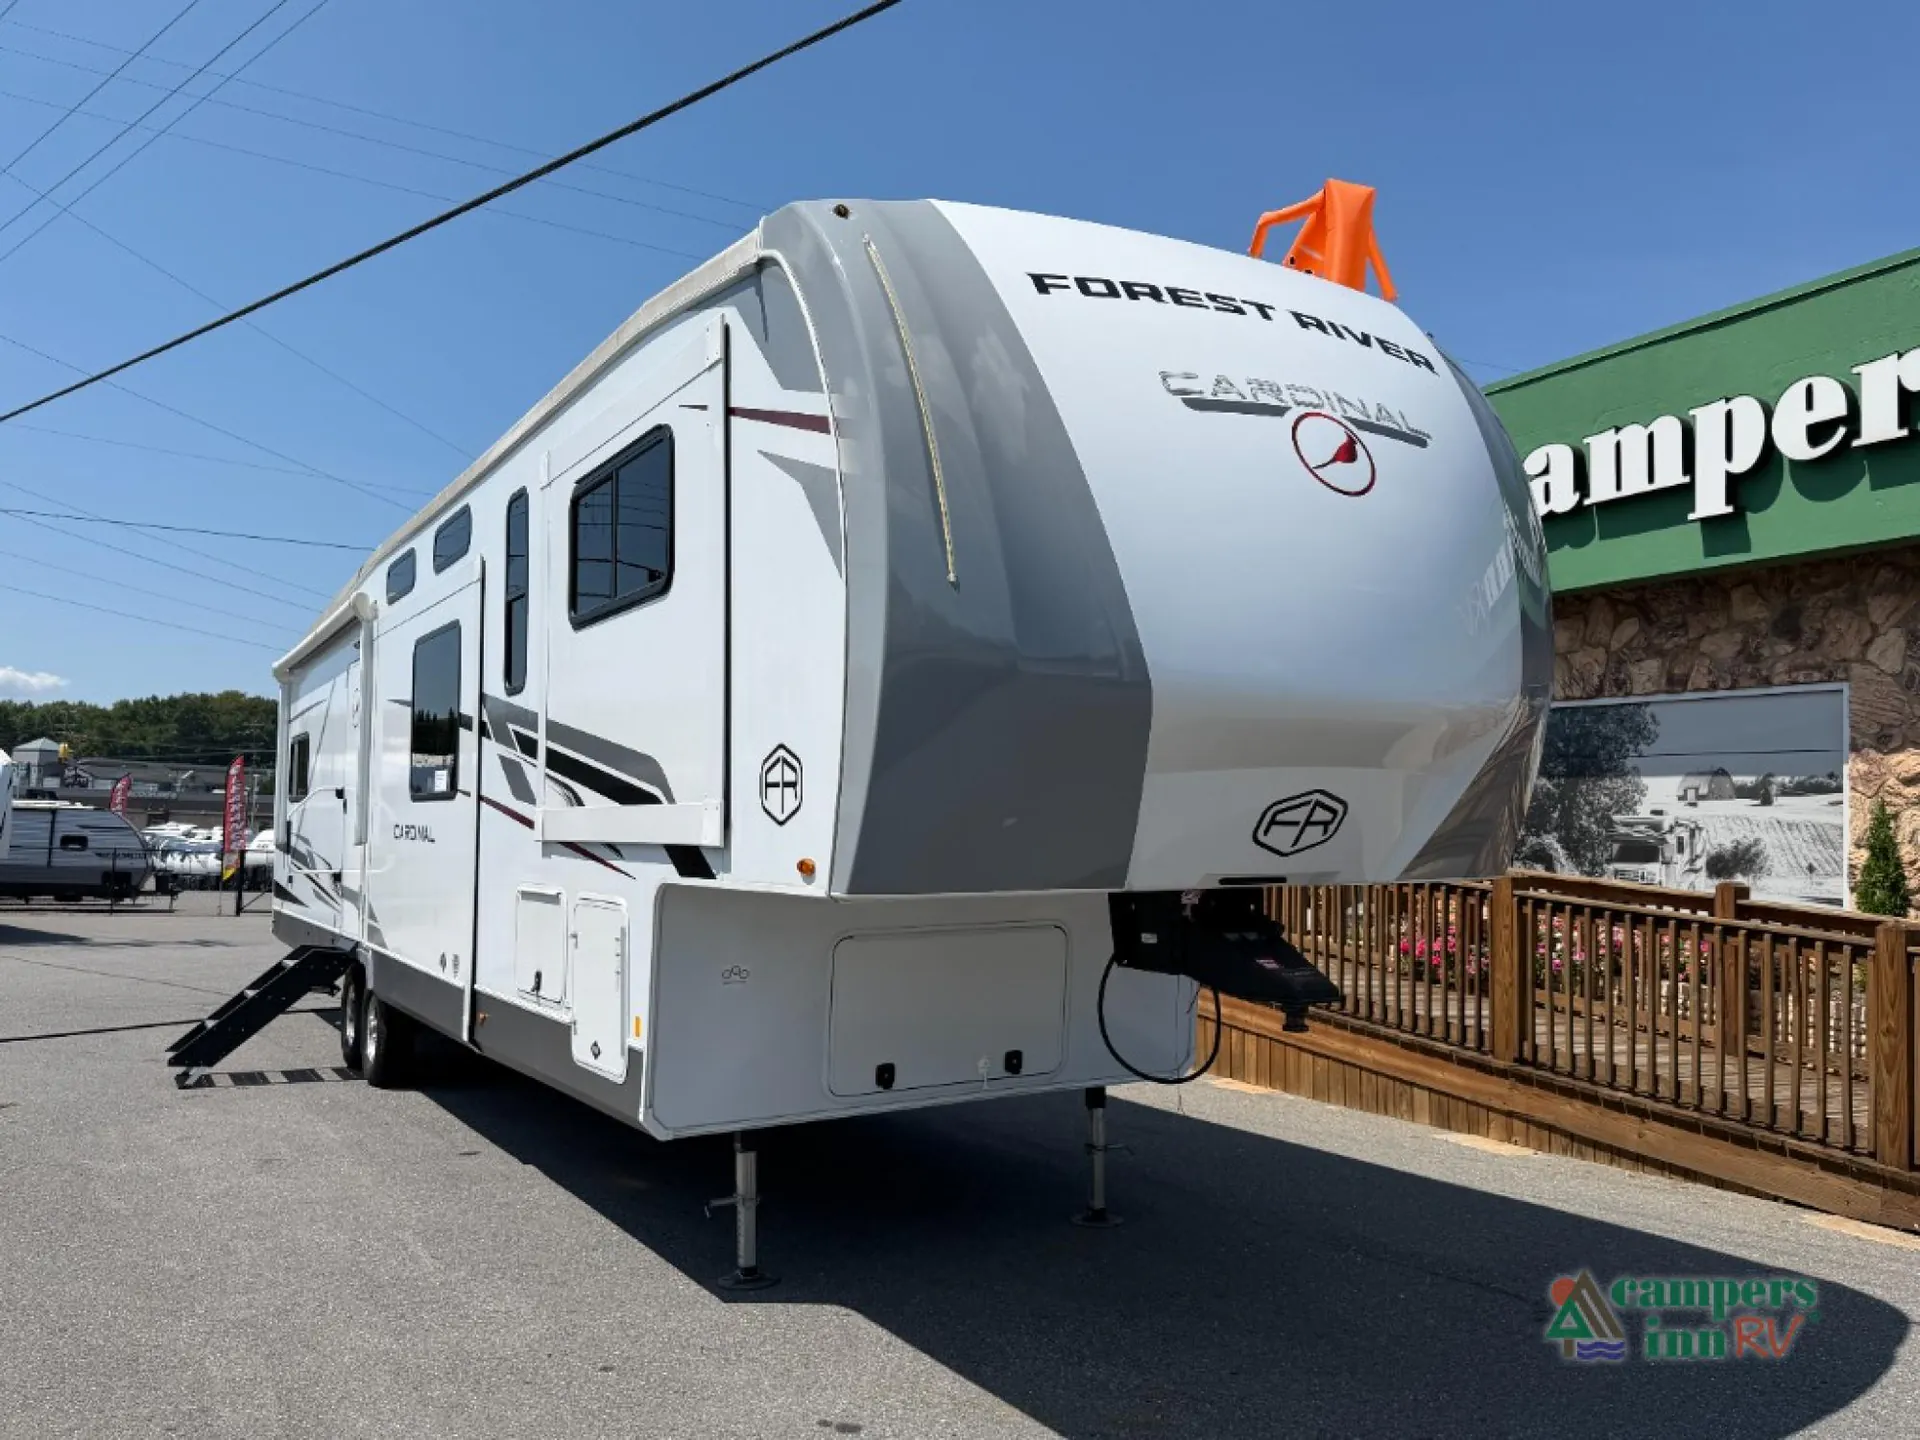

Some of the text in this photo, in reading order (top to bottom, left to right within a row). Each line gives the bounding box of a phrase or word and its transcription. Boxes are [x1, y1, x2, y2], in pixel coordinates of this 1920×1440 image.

[1026, 271, 1441, 378] FOREST RIVER
[1158, 370, 1434, 440] CARDINAL
[1523, 345, 1920, 521] amper
